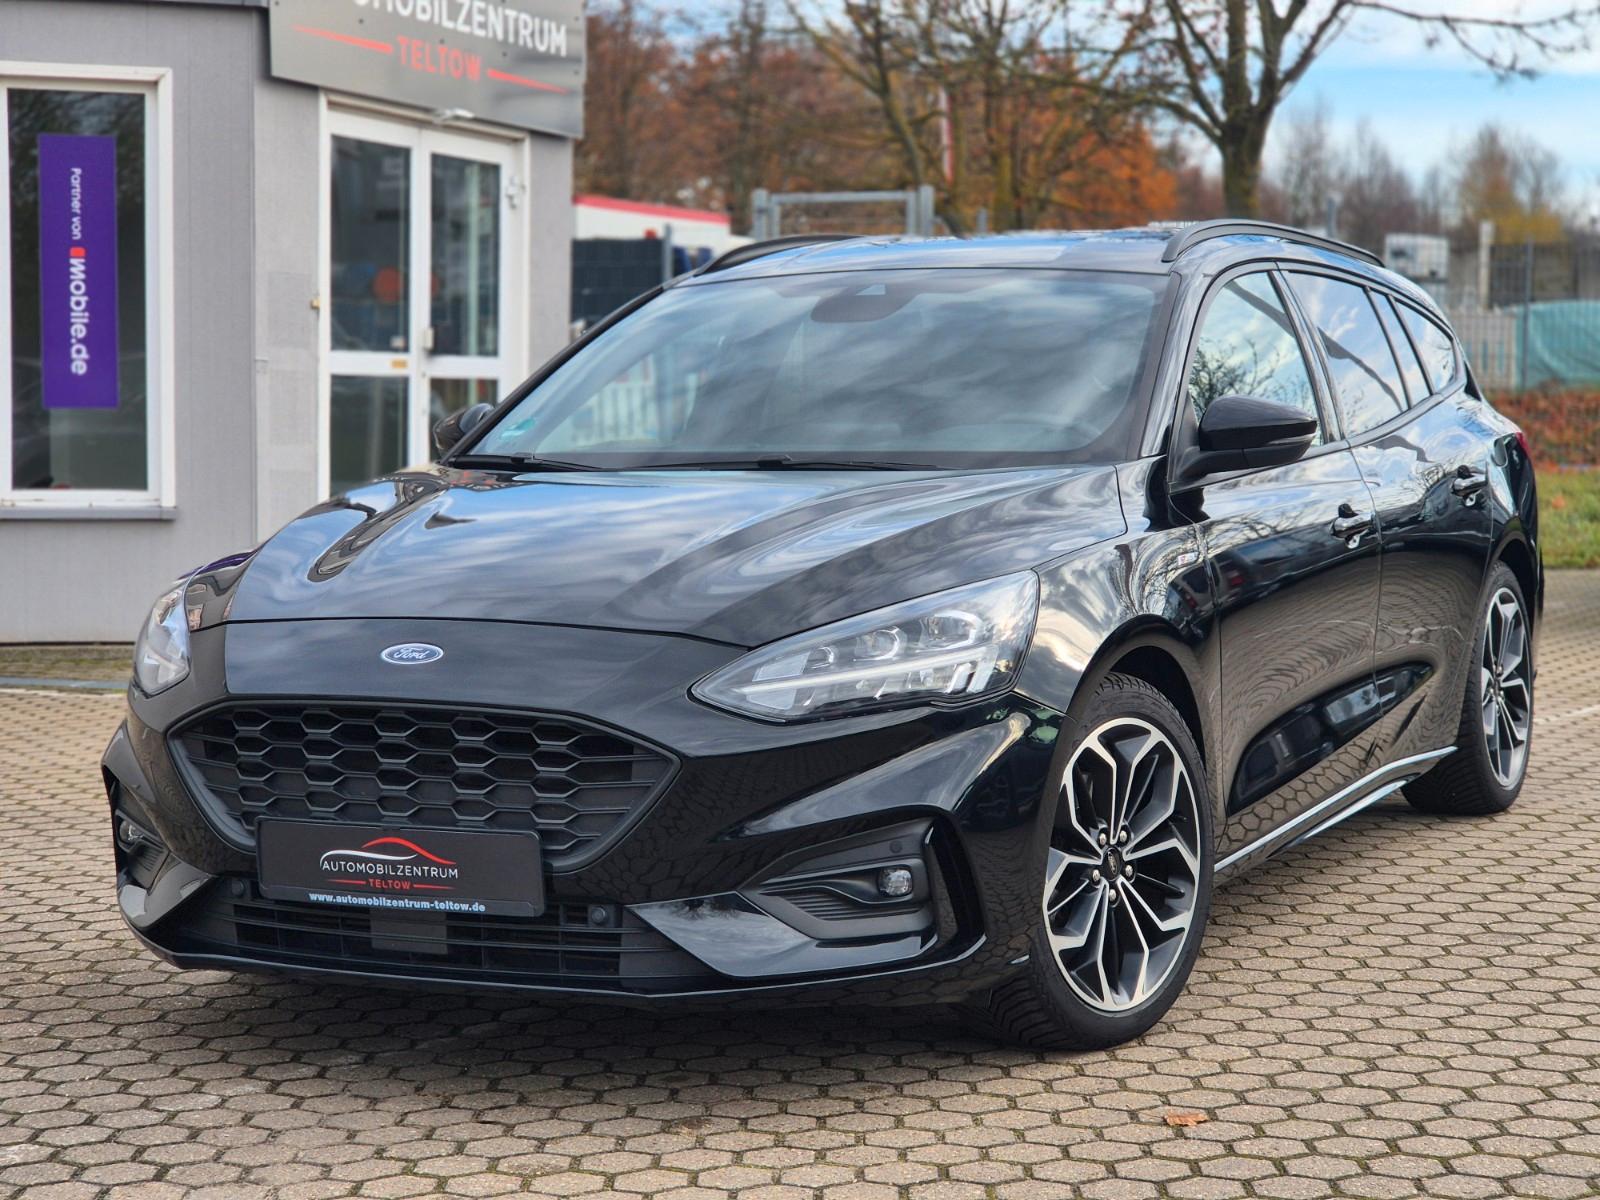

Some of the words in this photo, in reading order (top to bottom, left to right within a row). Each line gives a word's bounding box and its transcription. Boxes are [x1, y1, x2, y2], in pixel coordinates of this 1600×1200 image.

[353, 0, 567, 57] OBILZENTRUM
[397, 35, 482, 81] TELTOW
[71, 167, 82, 214] Partner
[72, 216, 82, 240] von
[69, 258, 90, 375] mobile.de
[393, 647, 430, 660] Ford
[322, 860, 458, 879] AUTOMOBILZENTRUM
[368, 878, 411, 890] TELTOW
[308, 893, 486, 912] www.automobilzentrum-teltow.de
